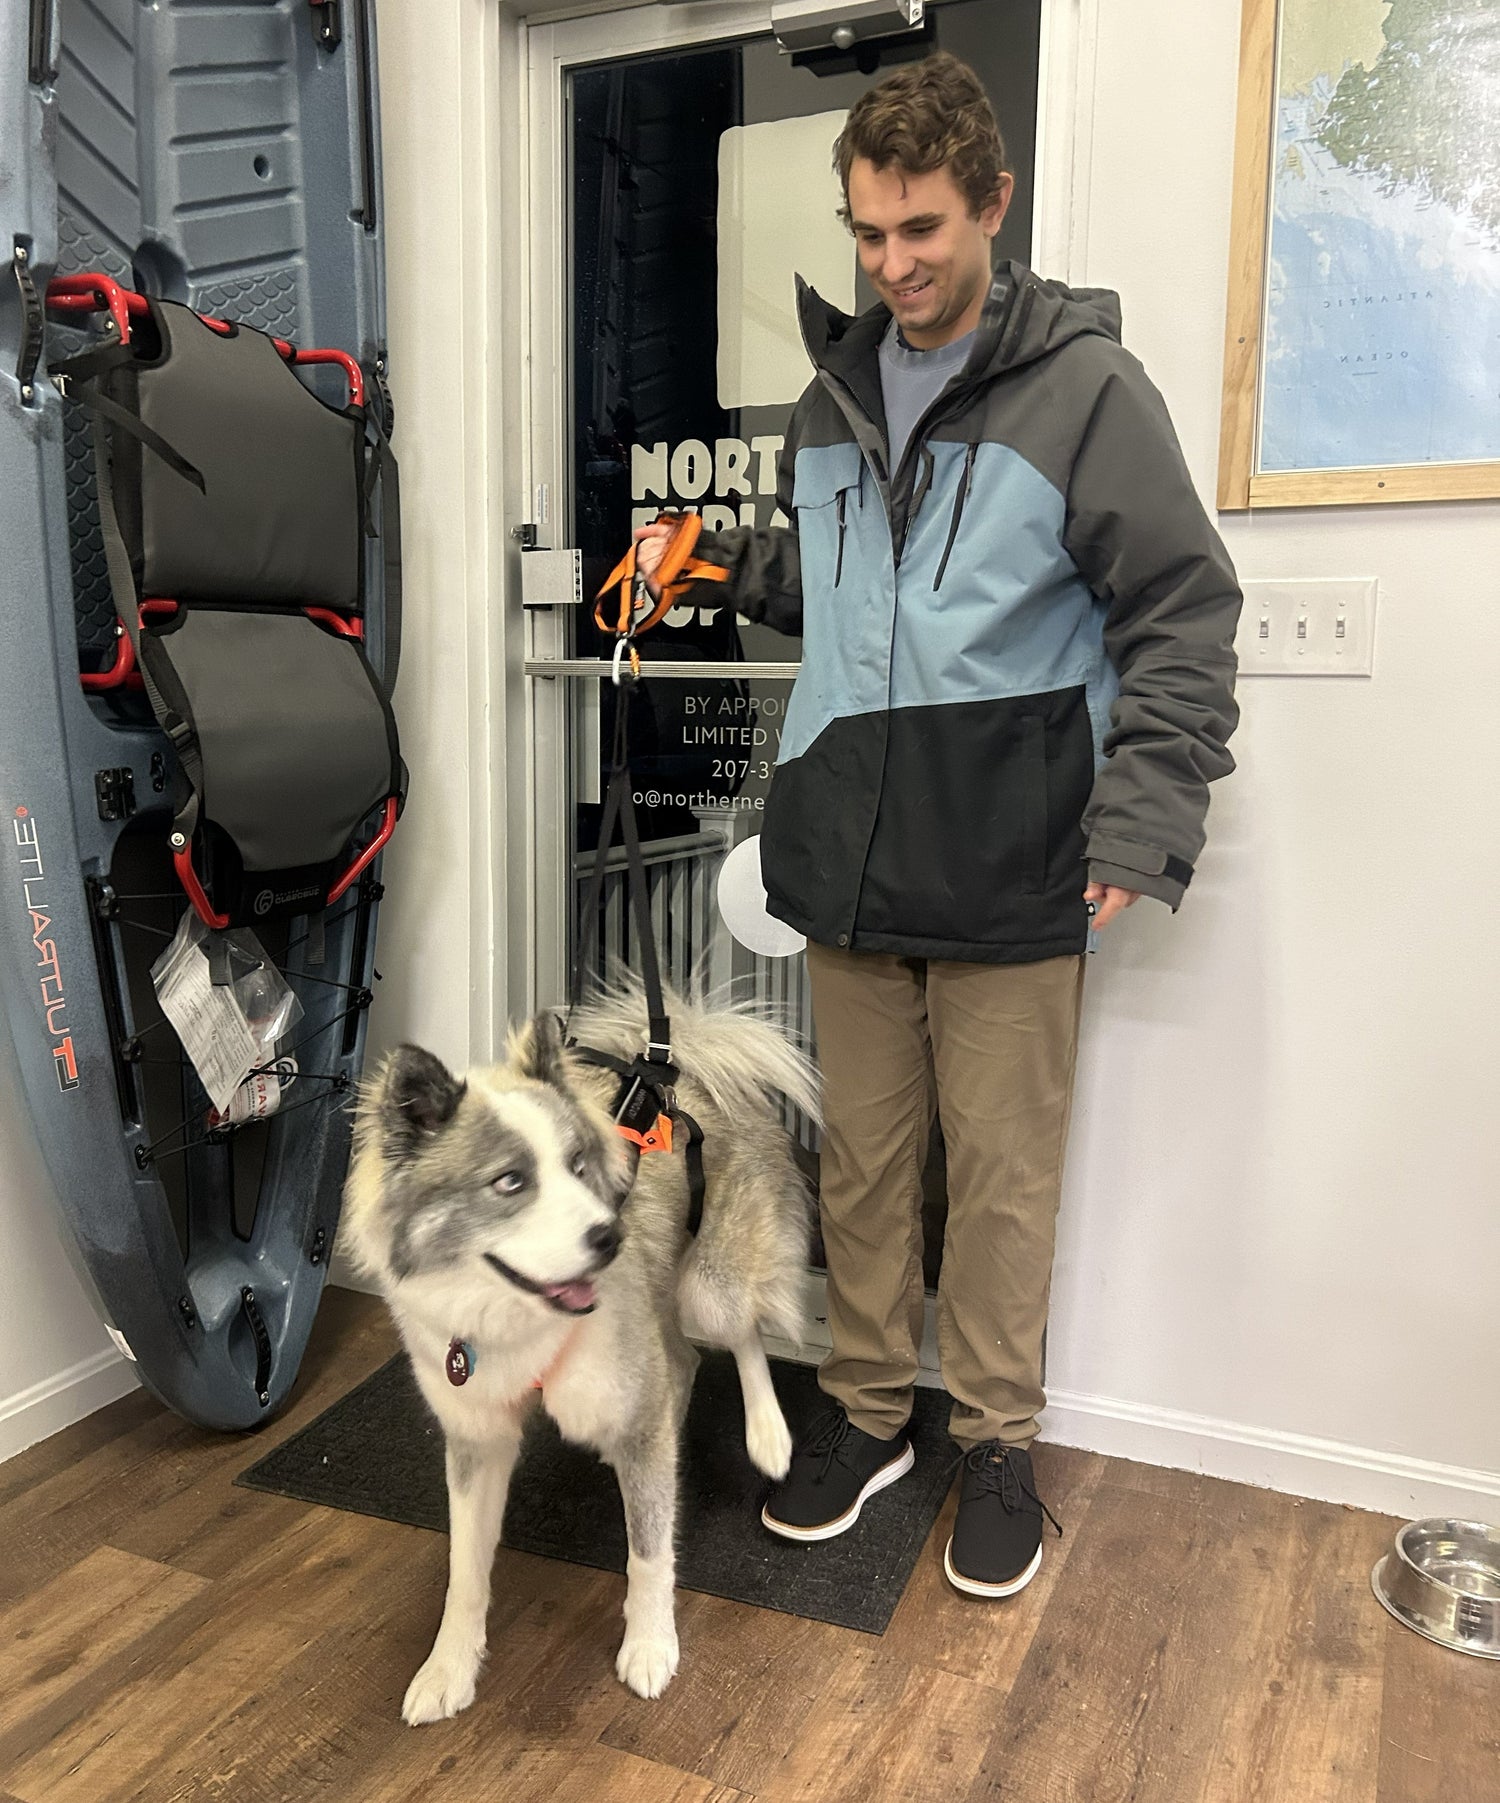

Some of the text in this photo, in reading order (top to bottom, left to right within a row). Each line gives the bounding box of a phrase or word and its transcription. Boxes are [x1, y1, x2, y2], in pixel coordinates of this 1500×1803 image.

[631, 434, 785, 501] NORT
[684, 696, 711, 715] BY
[682, 726, 768, 746] LIMITED
